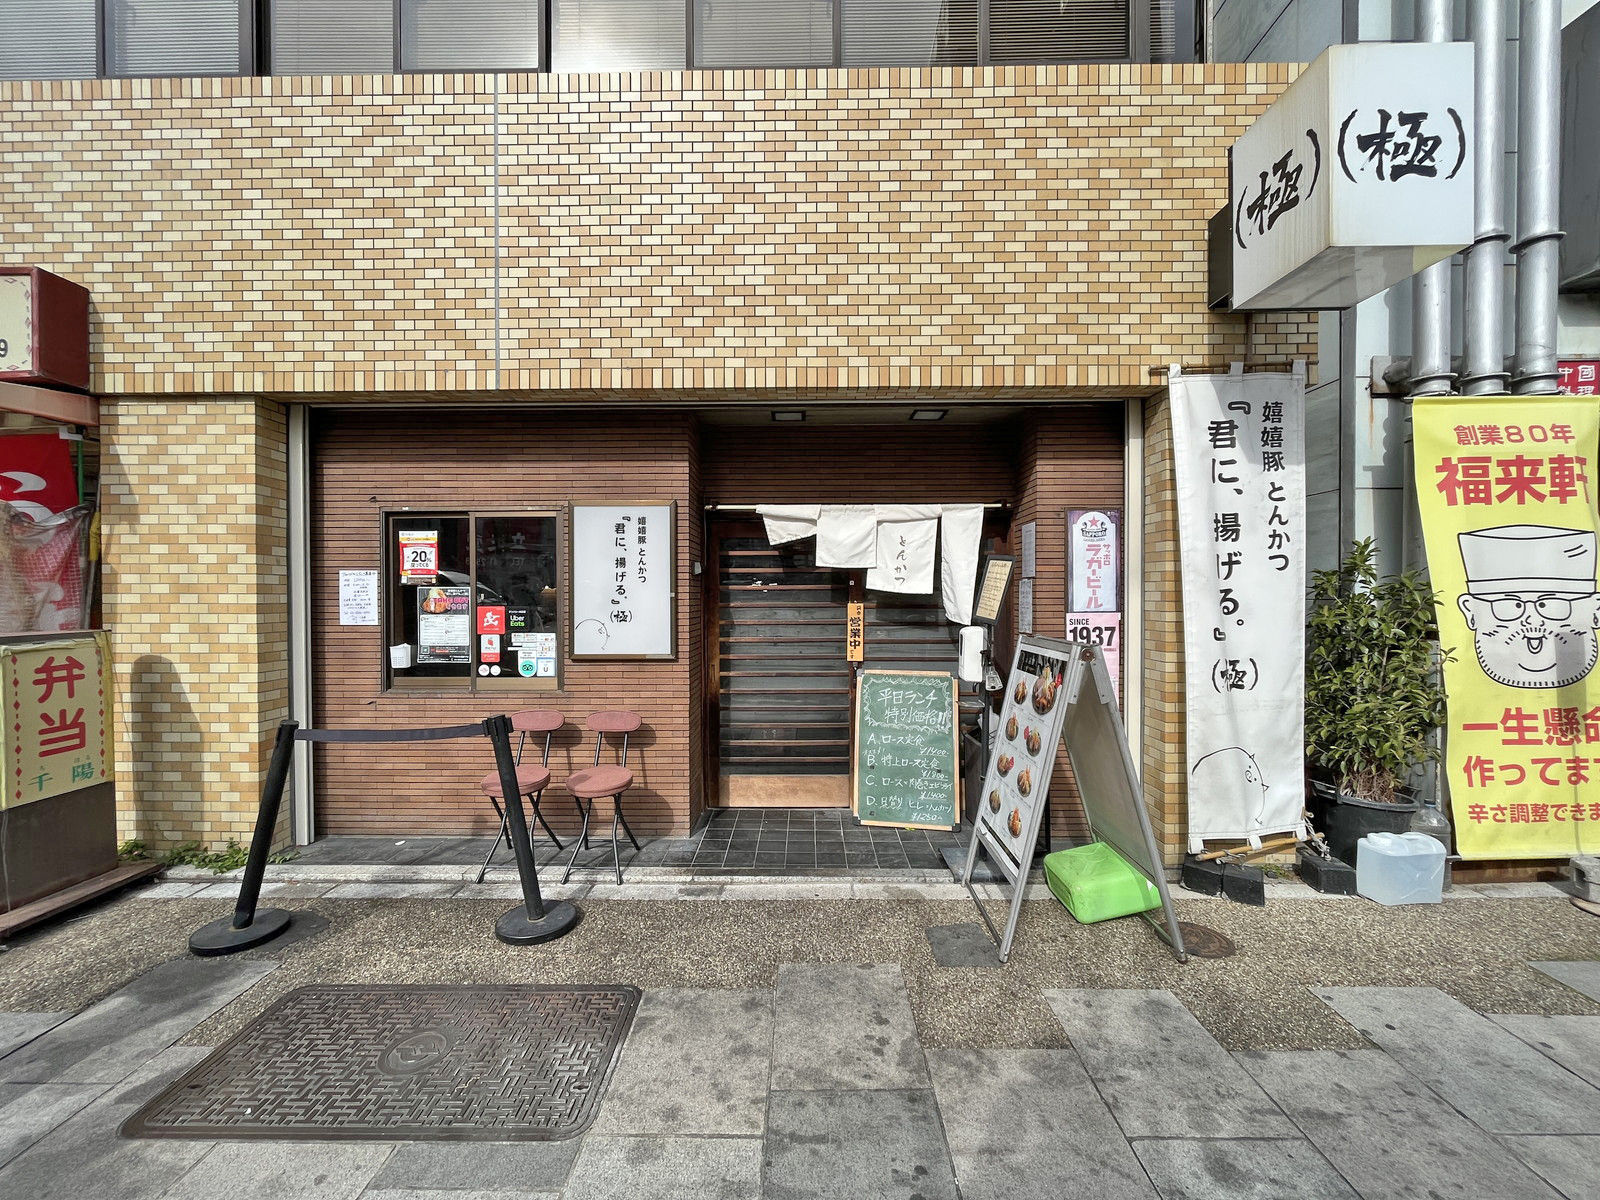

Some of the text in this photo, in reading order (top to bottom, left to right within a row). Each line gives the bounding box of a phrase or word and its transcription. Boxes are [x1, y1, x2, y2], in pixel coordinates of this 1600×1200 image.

[1337, 107, 1466, 183] (極)
[1235, 128, 1321, 249] (極)
[1453, 423, 1576, 446] 創業80年
[1435, 453, 1590, 507] 福来軒
[1267, 481, 1291, 572] とんかつ
[637, 548, 648, 583] とんかつ
[894, 535, 907, 586] とんかつ
[1103, 543, 1111, 566] サッポロ
[1086, 543, 1104, 609] ラガービール
[510, 614, 525, 622] Uber
[850, 616, 862, 650] 営業中
[1069, 618, 1090, 626] SINCE
[1069, 626, 1117, 647] 1937
[32, 655, 86, 758] 弁当
[877, 688, 938, 708] 平日ランチ
[1463, 755, 1600, 788] 作ってま
